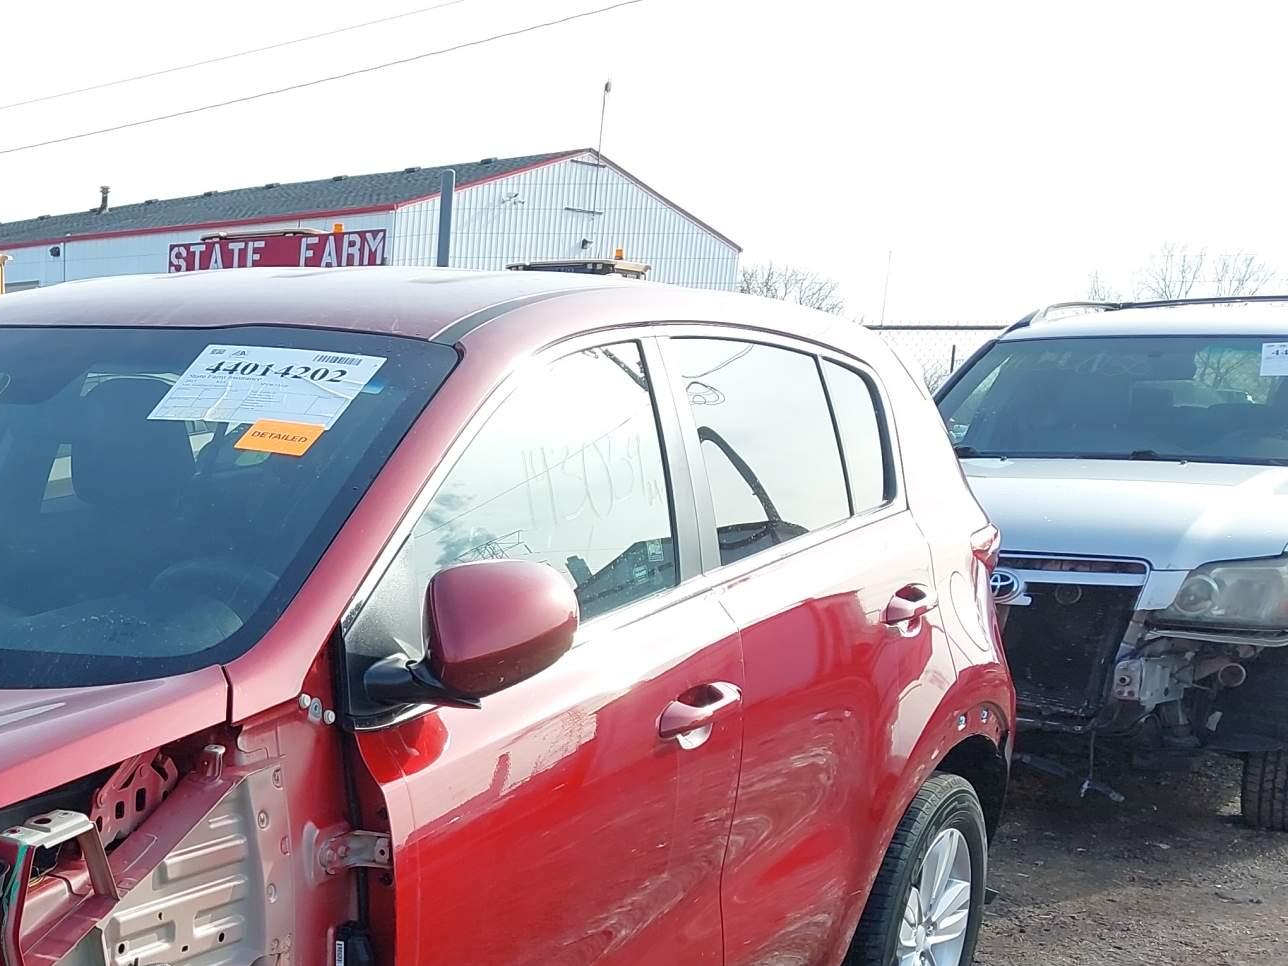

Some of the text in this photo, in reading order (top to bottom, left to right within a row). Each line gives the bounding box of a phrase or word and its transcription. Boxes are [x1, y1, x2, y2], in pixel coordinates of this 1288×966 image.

[169, 231, 385, 274] STATE FARM
[205, 360, 349, 383] 44014202
[251, 429, 308, 444] DETAILED
